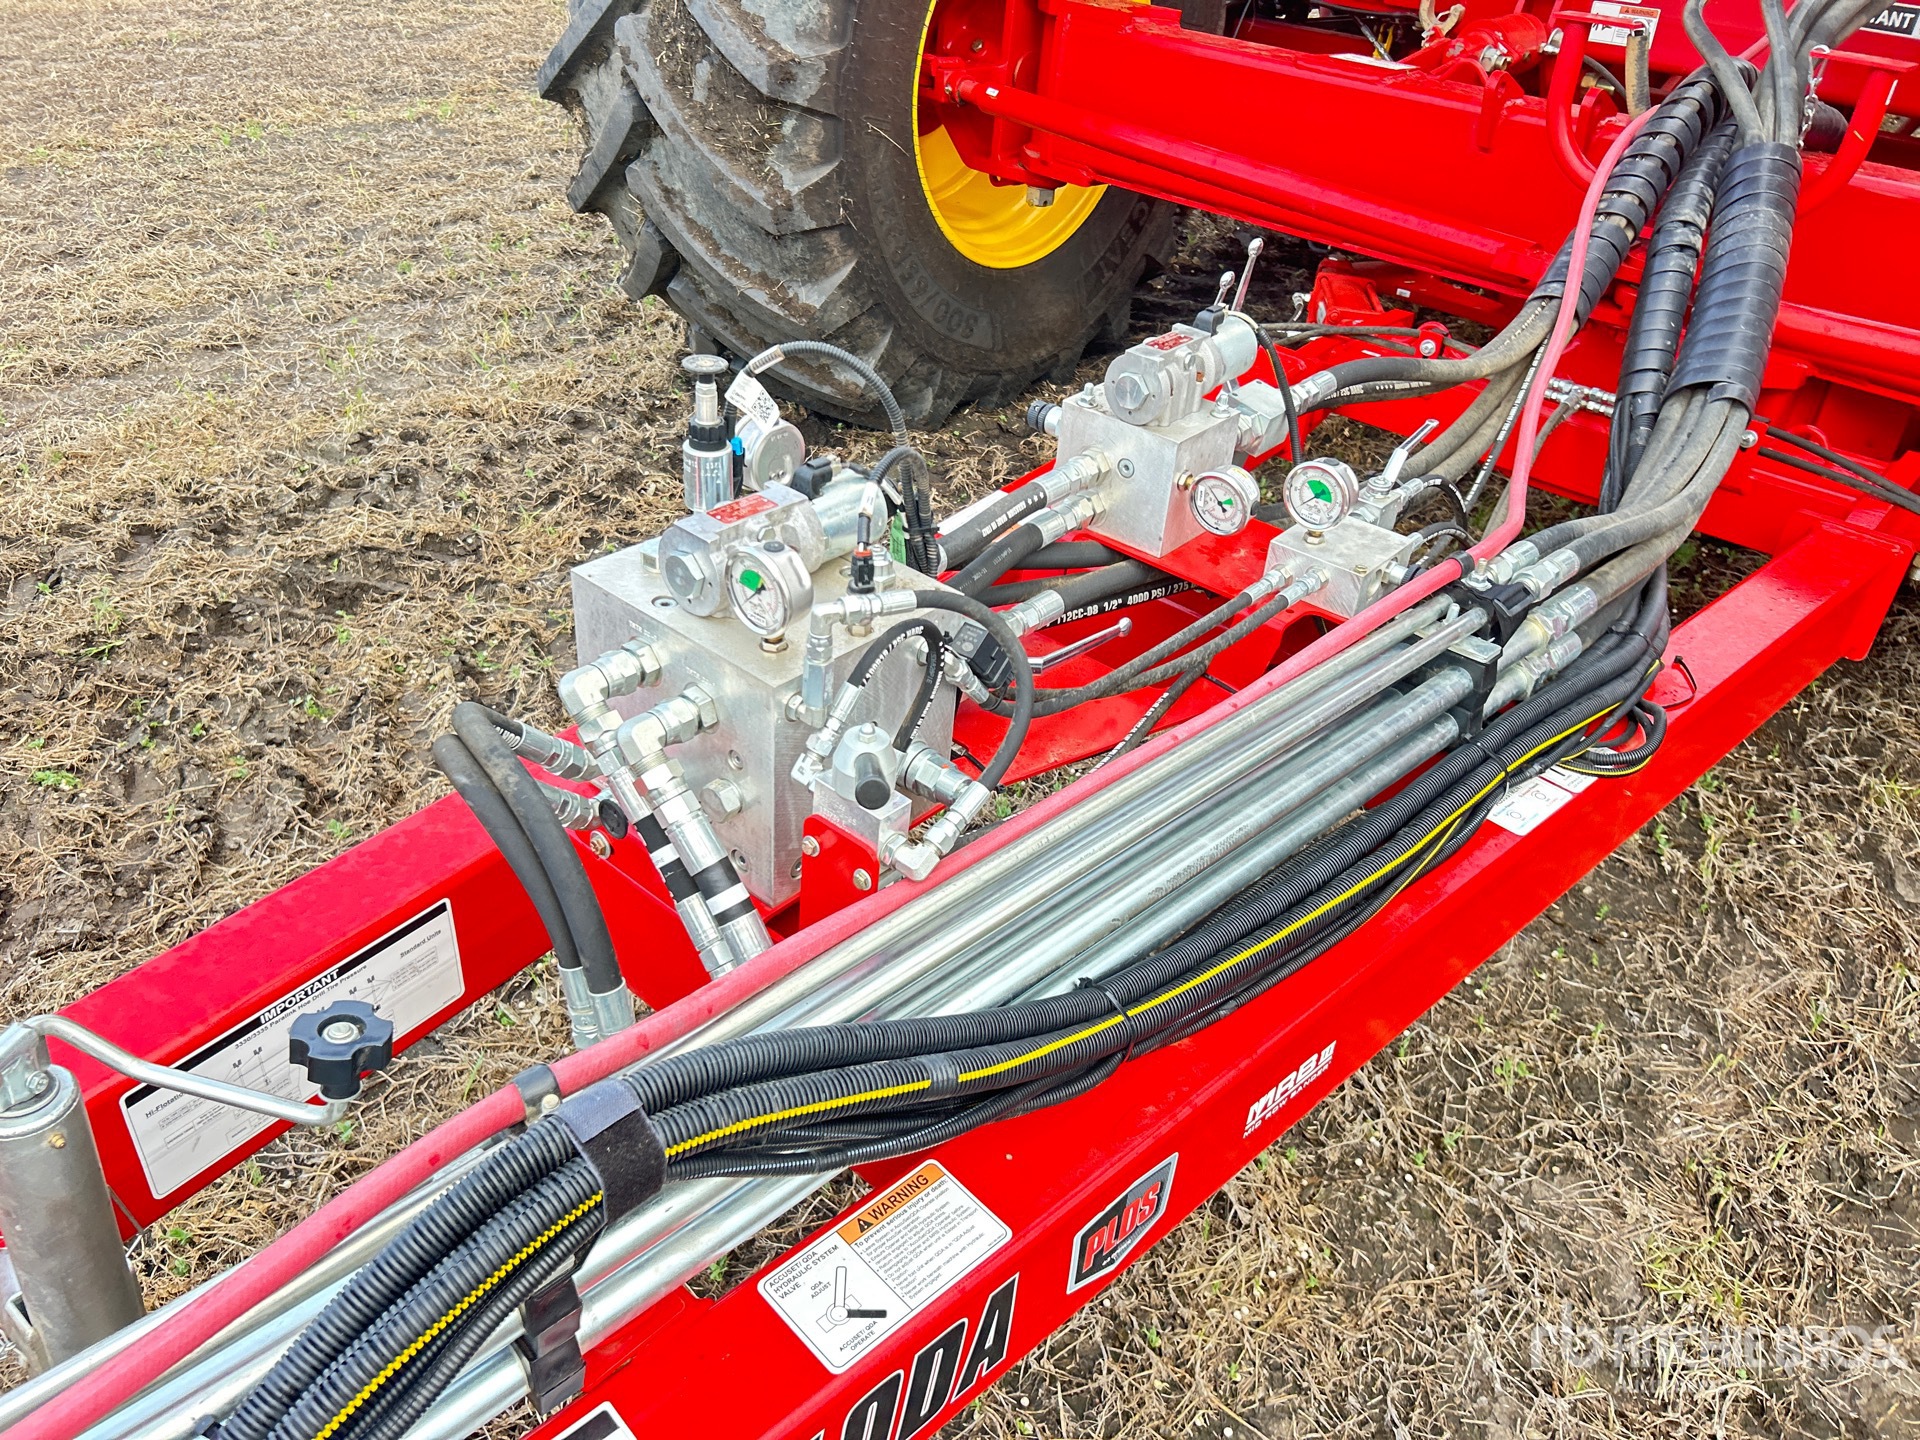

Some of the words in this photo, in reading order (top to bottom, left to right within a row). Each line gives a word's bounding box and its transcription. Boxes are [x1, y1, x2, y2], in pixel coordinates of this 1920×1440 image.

[1869, 9, 1916, 29] ANT
[399, 937, 426, 959] Standard
[426, 928, 441, 942] Units
[259, 968, 340, 1025] IMPORTANT
[269, 1006, 297, 1028] Paralink
[311, 989, 325, 1001] Drill
[326, 980, 339, 992] Tire
[339, 963, 366, 984] Pressure
[144, 1089, 184, 1118] Hi-Flotatio
[1246, 1052, 1318, 1125] MRB
[1242, 1119, 1262, 1139] MID
[1265, 1097, 1288, 1120] ROW
[866, 1172, 931, 1221] WARNING
[918, 1197, 936, 1211] Operate
[933, 1186, 950, 1200] position
[854, 1239, 864, 1248] To
[862, 1223, 887, 1243] prevent
[884, 1208, 908, 1226] serious
[906, 1195, 925, 1211] injury
[922, 1190, 931, 1198] or
[916, 1210, 937, 1226] Hydraulic
[934, 1200, 951, 1213] System
[1082, 1181, 1161, 1274] PLDS
[871, 1240, 887, 1253] proper
[767, 1261, 803, 1287] ACCUSET/
[801, 1250, 818, 1264] QDA
[772, 1263, 812, 1294] HYDRAULIC
[810, 1244, 839, 1266] SYSTEM
[778, 1281, 801, 1299] VALVE
[809, 1279, 823, 1291] QDA
[809, 1281, 832, 1299] ADJUST
[849, 1329, 875, 1351] OPERATE
[864, 1319, 878, 1331] QDA
